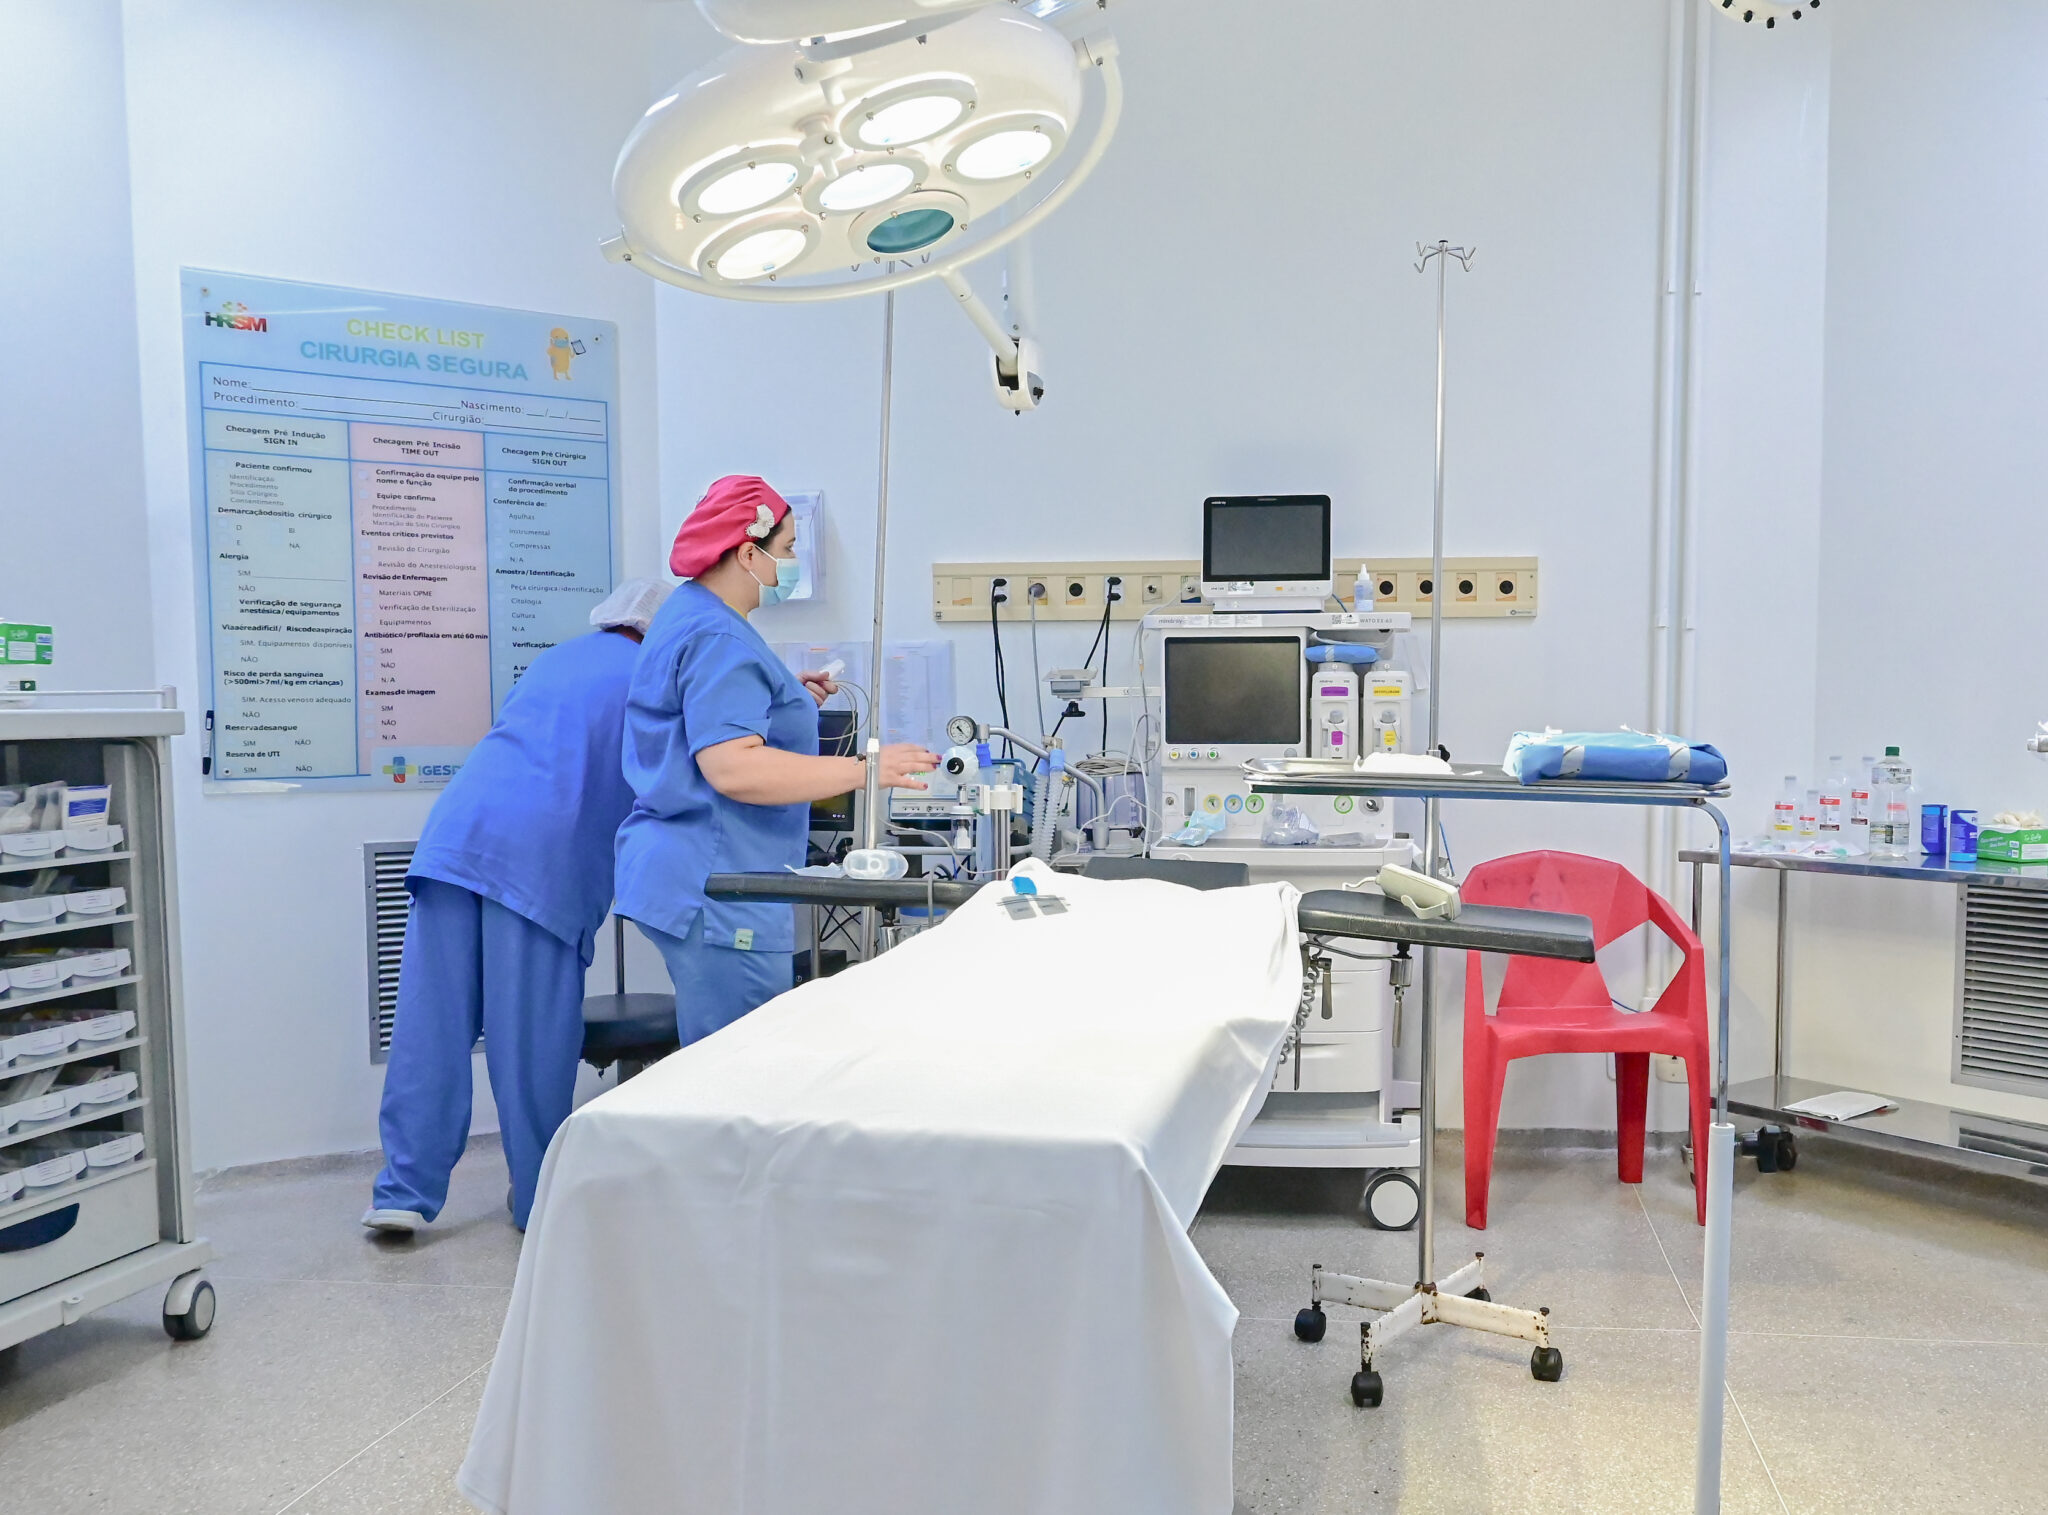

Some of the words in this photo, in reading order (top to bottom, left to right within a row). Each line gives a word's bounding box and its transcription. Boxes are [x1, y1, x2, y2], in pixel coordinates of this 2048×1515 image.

[205, 312, 267, 332] HRSM
[346, 318, 431, 343] CHECK
[436, 329, 485, 349] LIST
[300, 341, 421, 369] CIRURGIA
[427, 354, 529, 381] SEGURA
[213, 377, 251, 388] Nome:
[214, 391, 298, 408] Procedimento:
[461, 400, 525, 414] Nascimento:
[432, 411, 484, 424] Cirurgião:
[226, 425, 270, 435] Checagem
[292, 431, 326, 439] Indução
[264, 437, 286, 445] SIGN
[373, 437, 413, 446] Checagem
[432, 442, 461, 450] Incisão
[501, 447, 540, 457] Checagem
[532, 458, 551, 466] SIGN
[235, 462, 270, 470] Paciente
[272, 465, 312, 474] confirmou
[376, 469, 424, 478] Confirmação
[436, 473, 462, 481] equipe
[406, 479, 432, 487] função
[508, 478, 553, 488] Confirmação
[554, 481, 577, 489] verbal
[519, 487, 568, 496] procedimento
[404, 494, 436, 502] confirma
[493, 498, 535, 506] Conferência
[219, 553, 249, 561] Alergia
[402, 574, 448, 582] Enfermagem
[239, 599, 286, 607] Verificação
